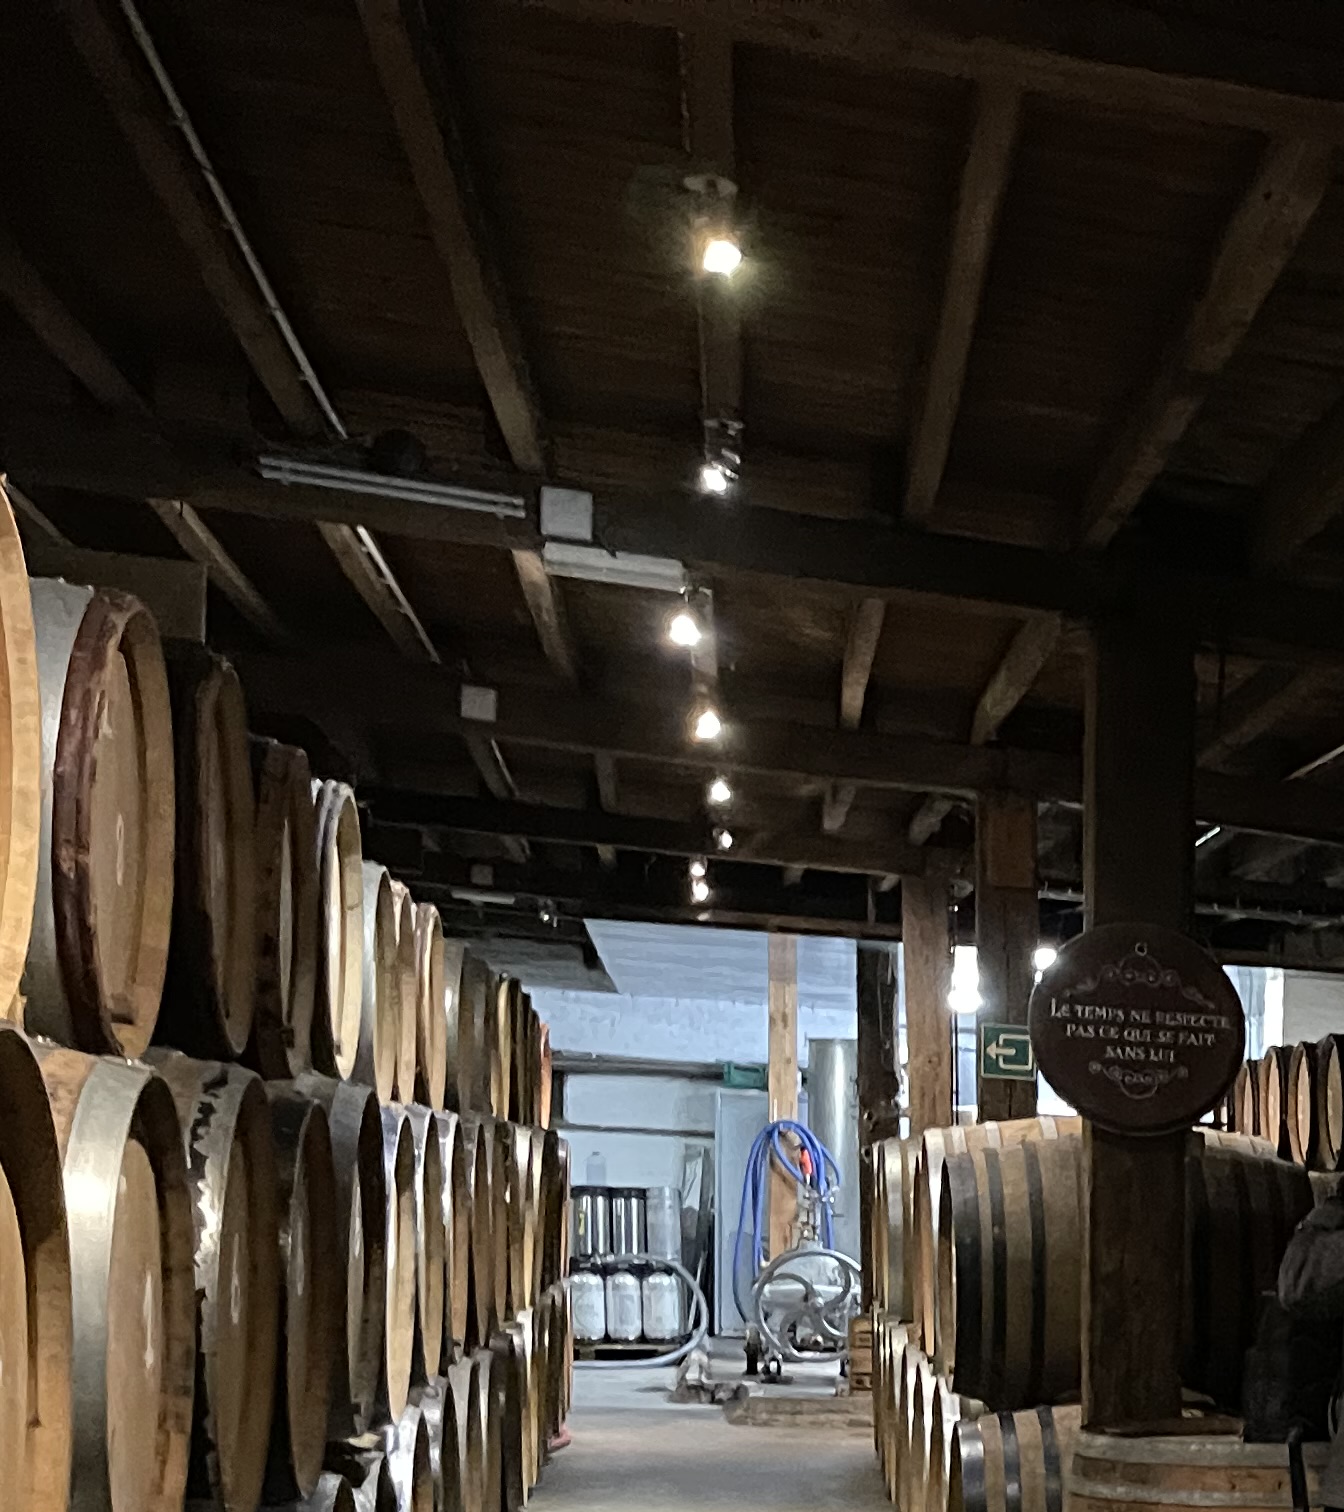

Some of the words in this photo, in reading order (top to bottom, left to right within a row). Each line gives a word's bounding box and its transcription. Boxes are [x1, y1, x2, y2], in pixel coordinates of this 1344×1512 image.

[1074, 1004, 1125, 1023] TEMPS
[1066, 1023, 1095, 1038] PAS
[1100, 1025, 1119, 1039] CE
[1123, 1027, 1151, 1042] QUI
[1158, 1030, 1175, 1044] SE
[1105, 1045, 1146, 1060] SANS
[1150, 1048, 1175, 1064] LUI
